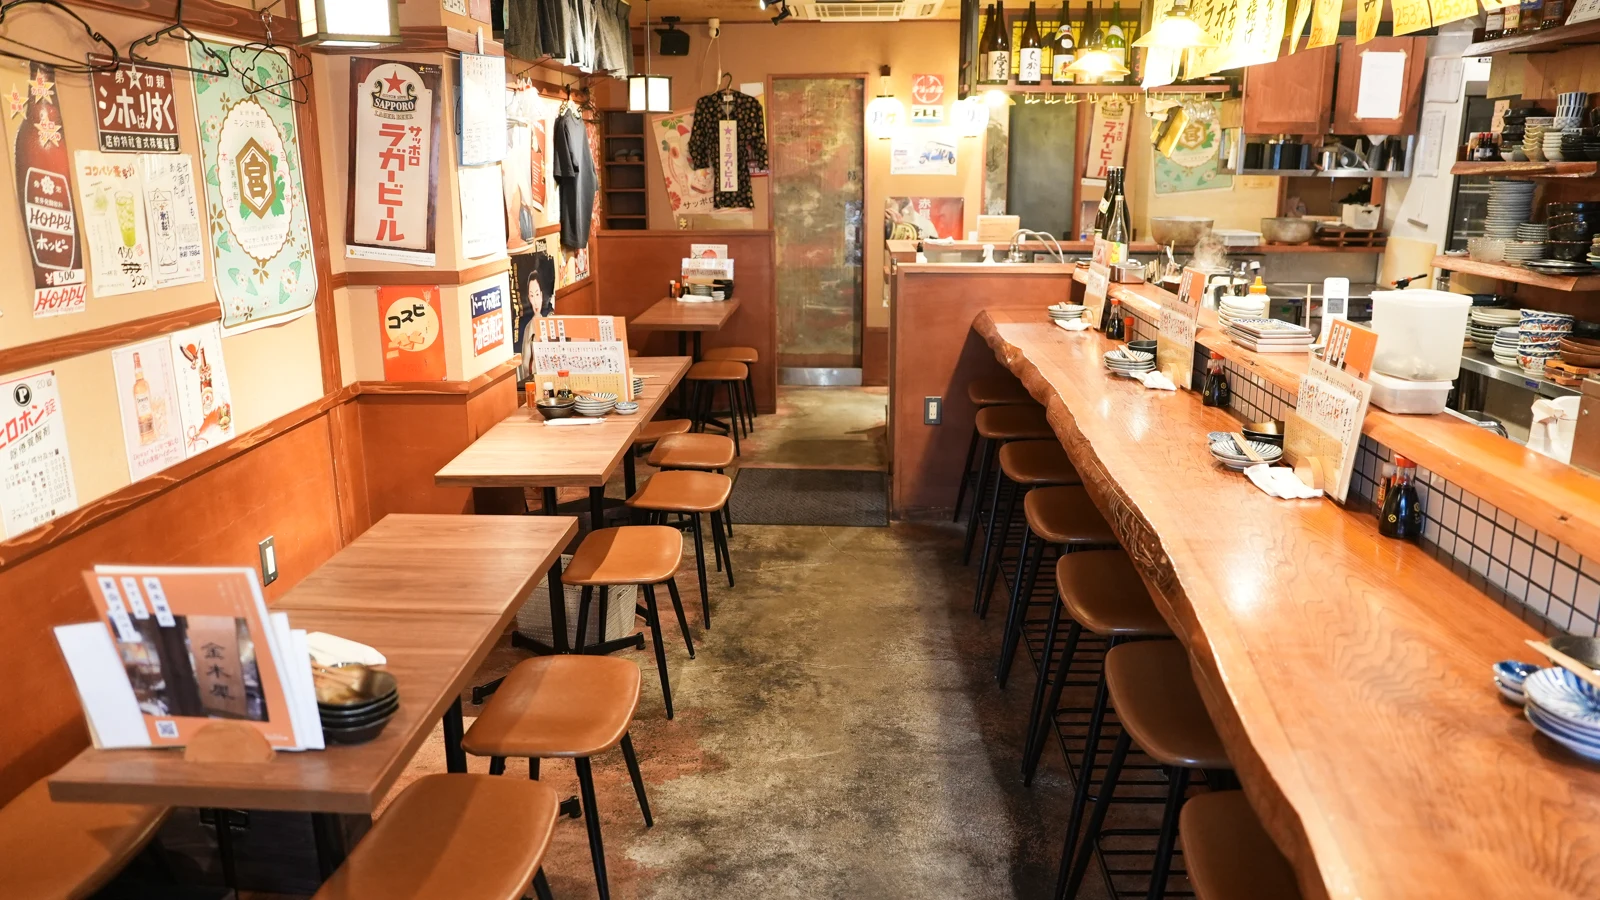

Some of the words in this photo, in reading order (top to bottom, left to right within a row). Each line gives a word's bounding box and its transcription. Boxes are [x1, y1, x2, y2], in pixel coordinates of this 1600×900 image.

[374, 98, 414, 111] SAPPORO
[409, 126, 422, 166] サッポロ
[1097, 121, 1117, 177] ラガービール
[376, 123, 407, 242] ラガービール
[30, 208, 72, 231] Hoppy
[36, 234, 69, 253] ホッピー
[34, 285, 87, 311] Hoppy
[18, 388, 28, 403] P
[201, 642, 236, 702] 金木犀
